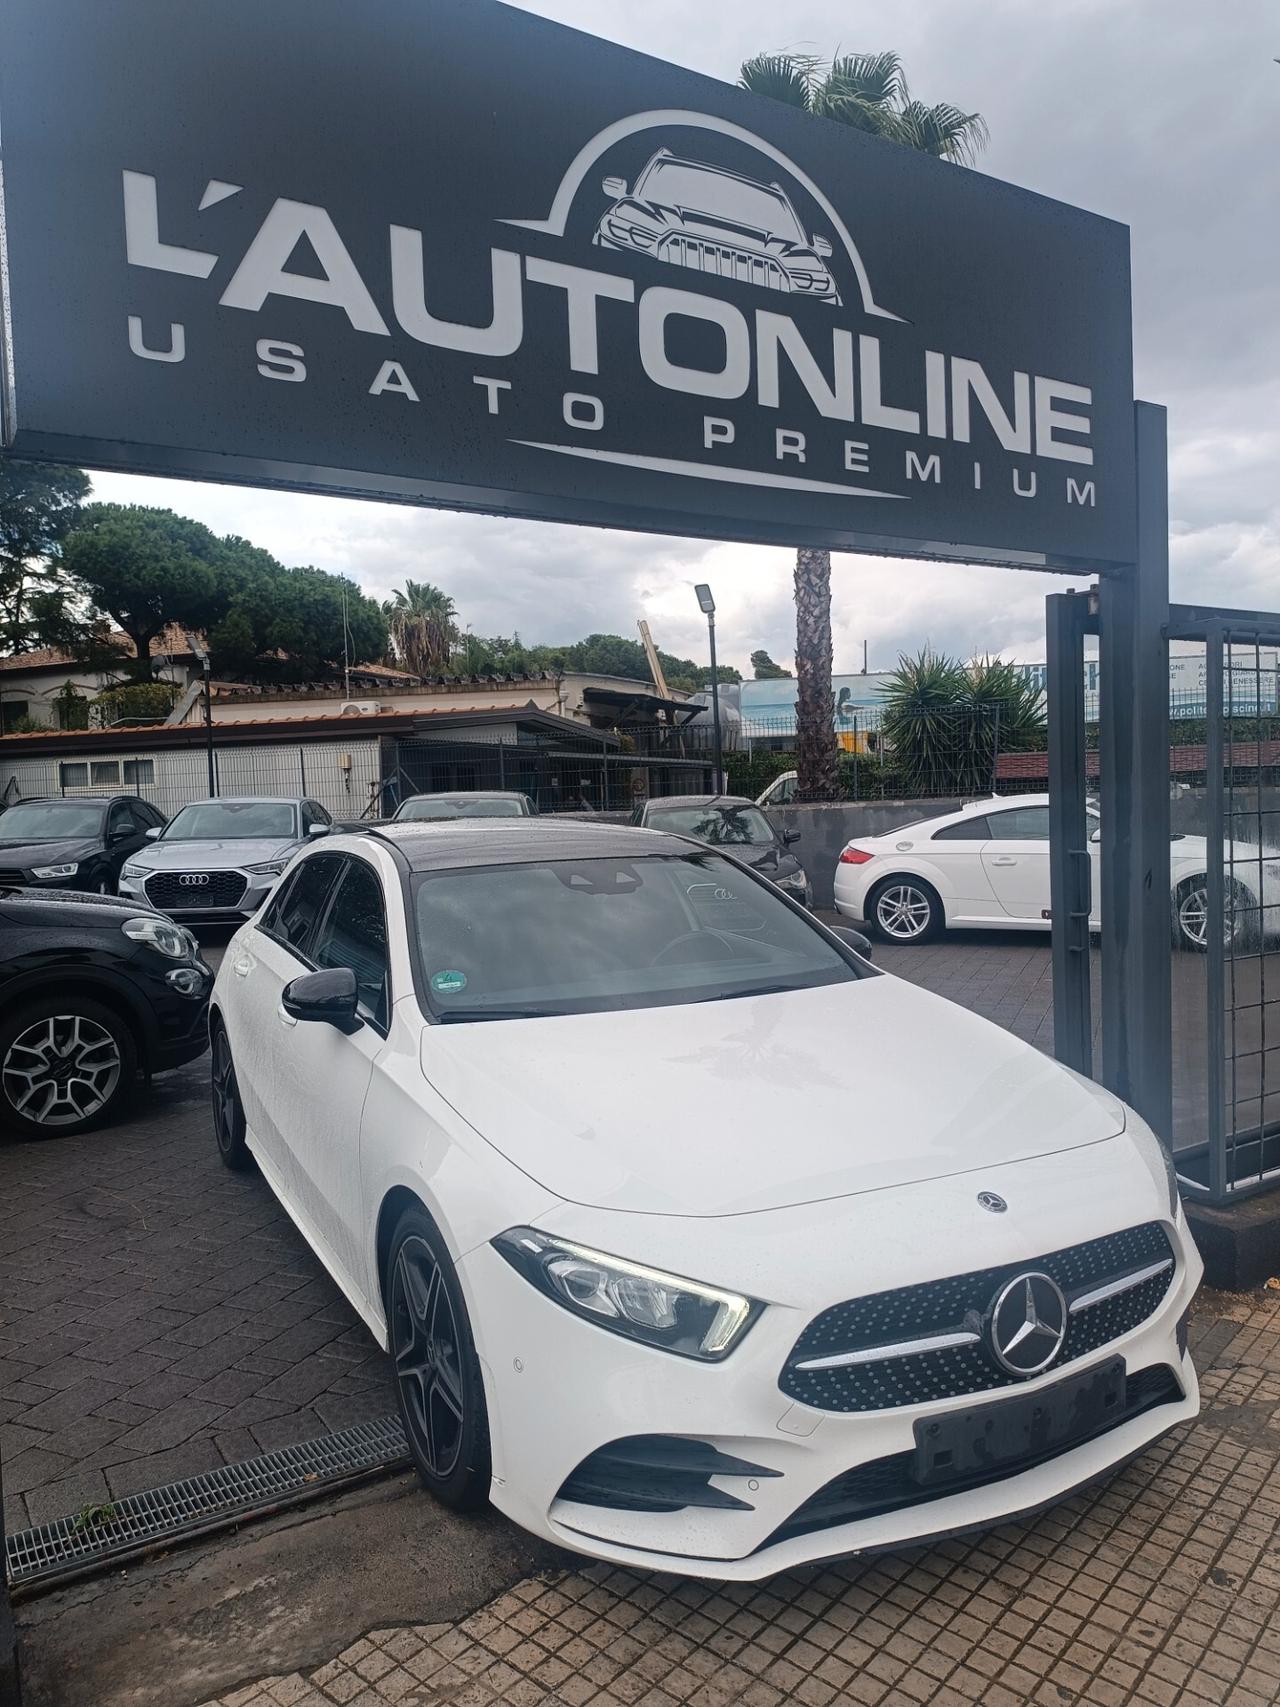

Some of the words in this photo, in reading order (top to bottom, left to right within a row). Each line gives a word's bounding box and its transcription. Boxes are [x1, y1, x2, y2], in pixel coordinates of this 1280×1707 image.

[122, 170, 1094, 465] L'AUTONLINE
[128, 315, 604, 431] USATO
[704, 416, 1095, 507] PREMIUM
